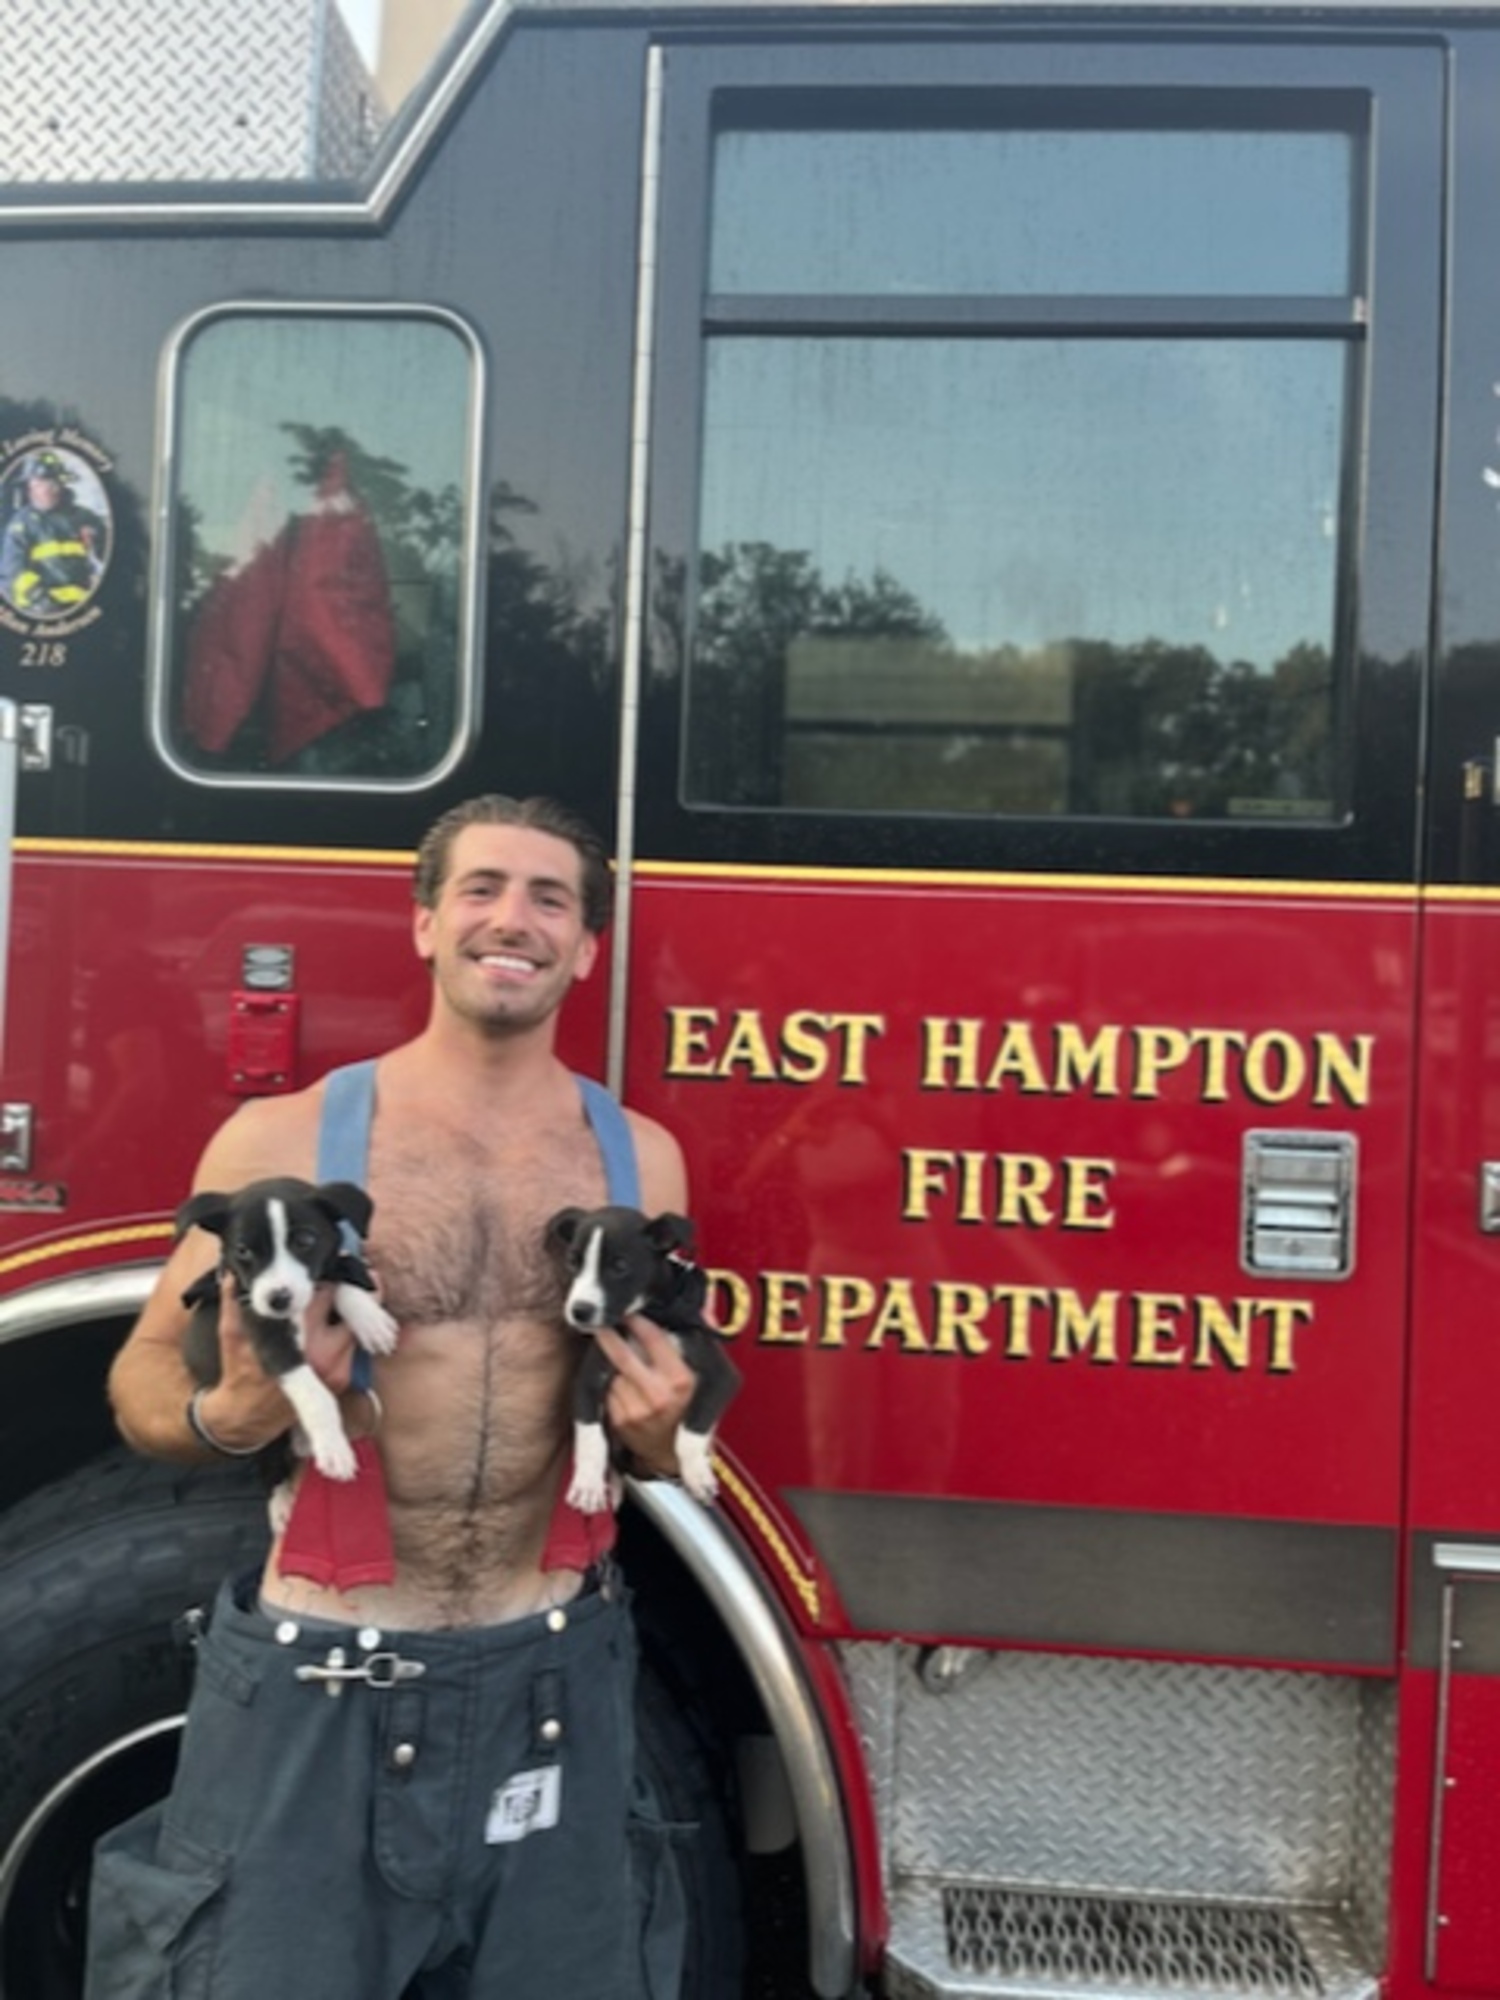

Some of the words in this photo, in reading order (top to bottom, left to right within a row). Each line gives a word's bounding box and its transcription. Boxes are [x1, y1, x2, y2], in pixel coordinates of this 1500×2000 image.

[19, 641, 68, 667] 218
[666, 1007, 885, 1086] EAST
[921, 1018, 1374, 1106] HAMPTON
[903, 1149, 1116, 1230] FIRE
[704, 1269, 1313, 1371] DEPARTMENT
